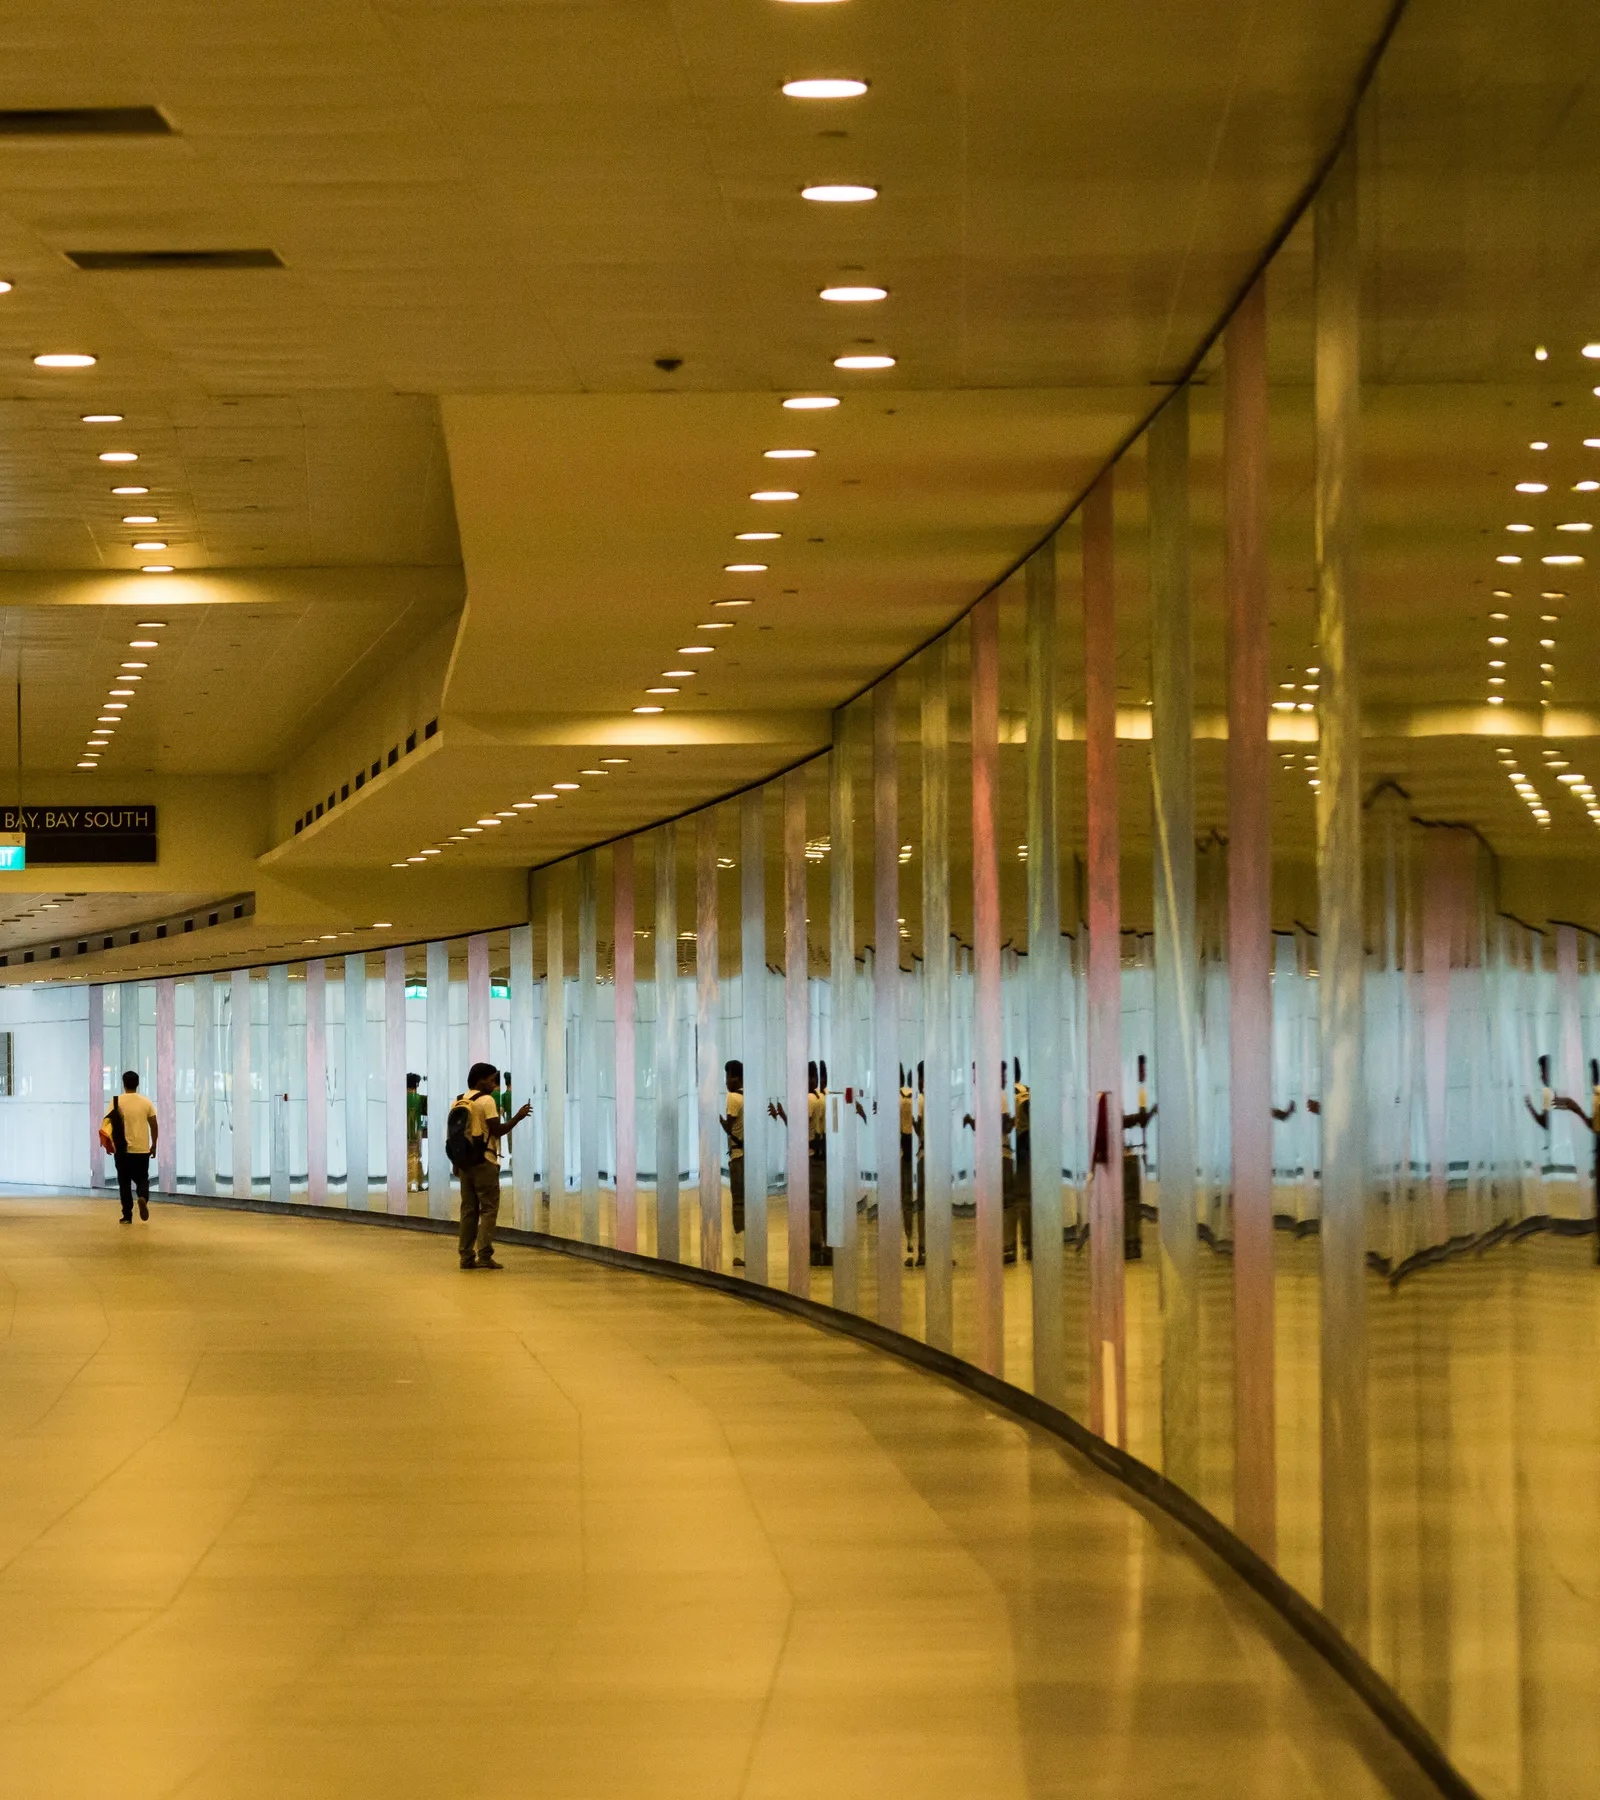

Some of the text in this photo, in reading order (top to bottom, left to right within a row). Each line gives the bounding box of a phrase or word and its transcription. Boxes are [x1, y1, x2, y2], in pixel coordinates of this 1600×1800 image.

[5, 812, 40, 829] BAY,
[45, 812, 80, 828] BAY
[84, 811, 148, 828] SOUTH
